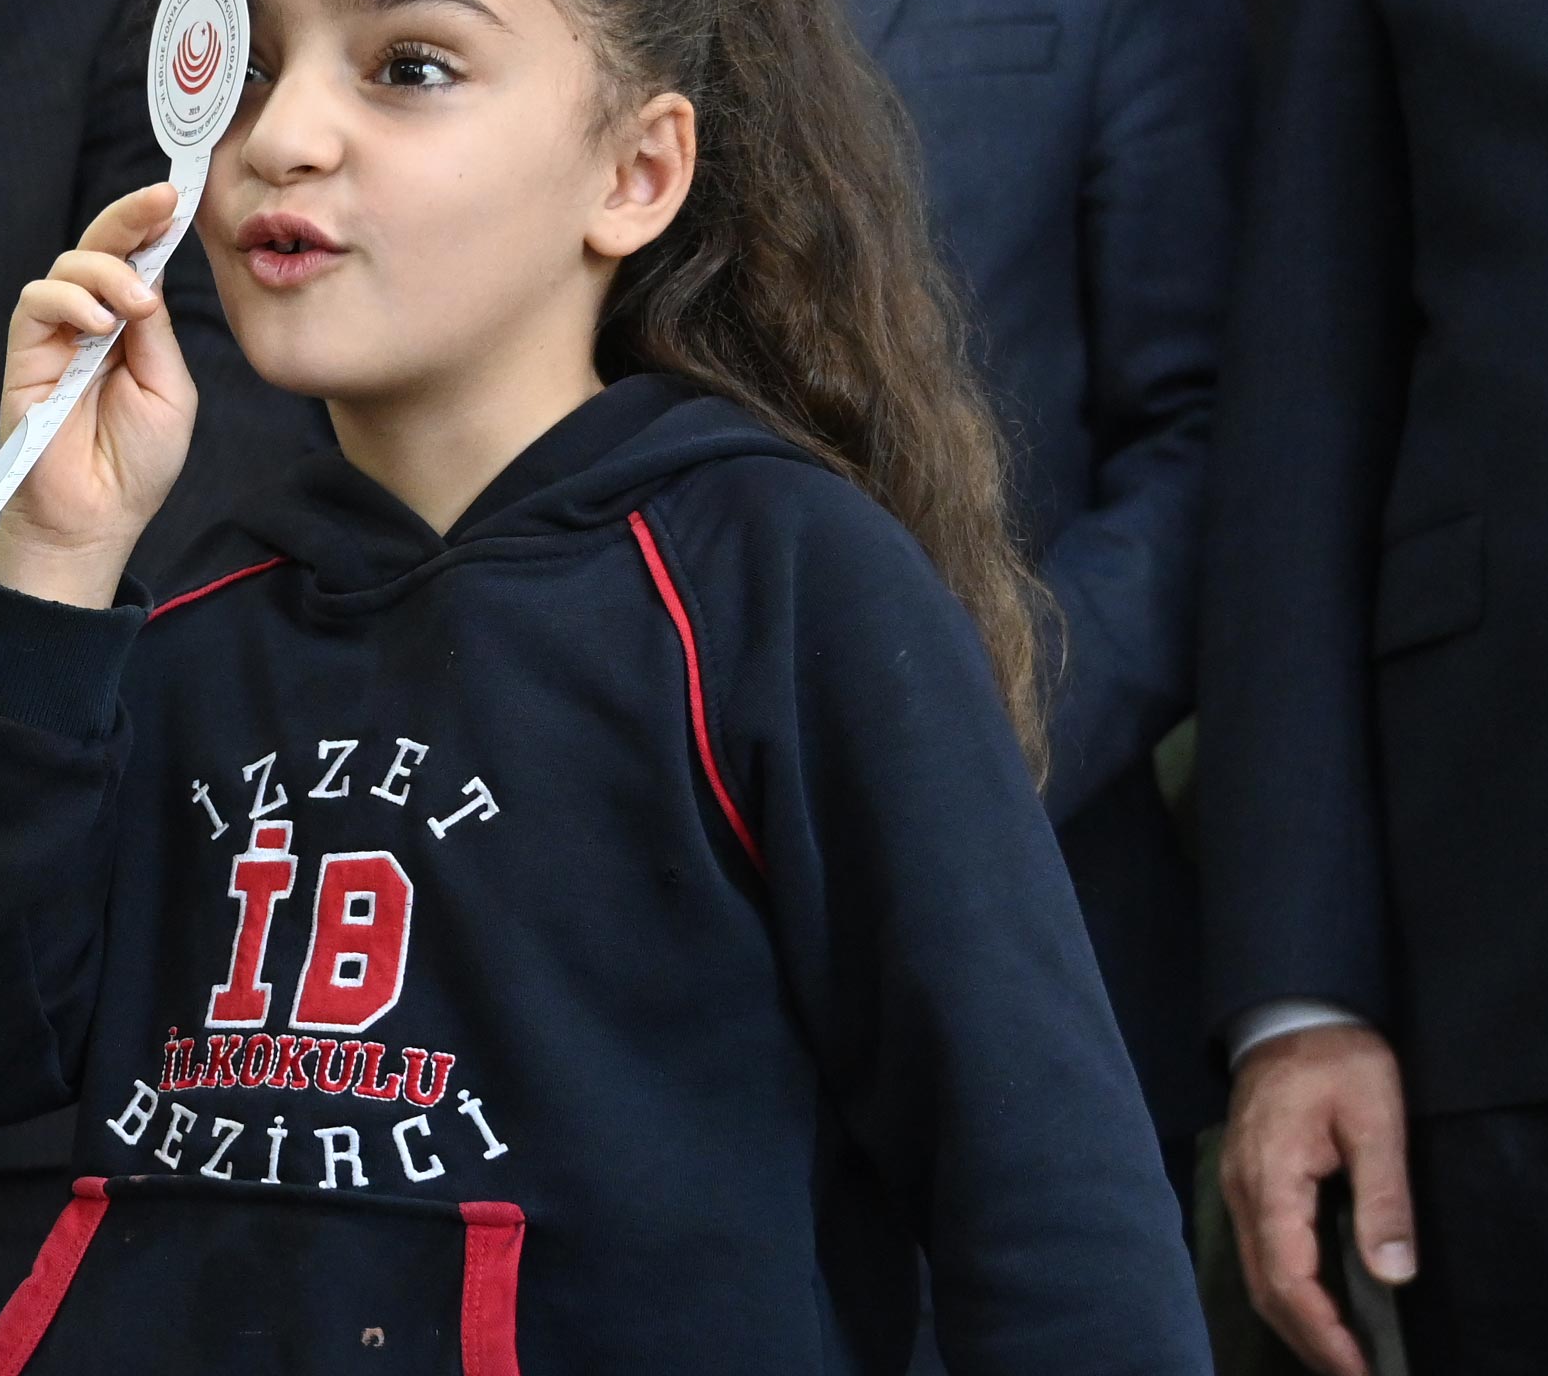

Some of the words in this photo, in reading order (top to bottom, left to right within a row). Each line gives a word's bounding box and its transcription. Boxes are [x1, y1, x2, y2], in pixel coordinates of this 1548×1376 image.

[163, 5, 178, 42] KONYA
[225, 46, 235, 84] ODASI
[192, 737, 500, 841] İZZET
[204, 819, 414, 1034] İB
[157, 1026, 456, 1108] İLKOKULU
[106, 1079, 509, 1190] BEZİRCİ
